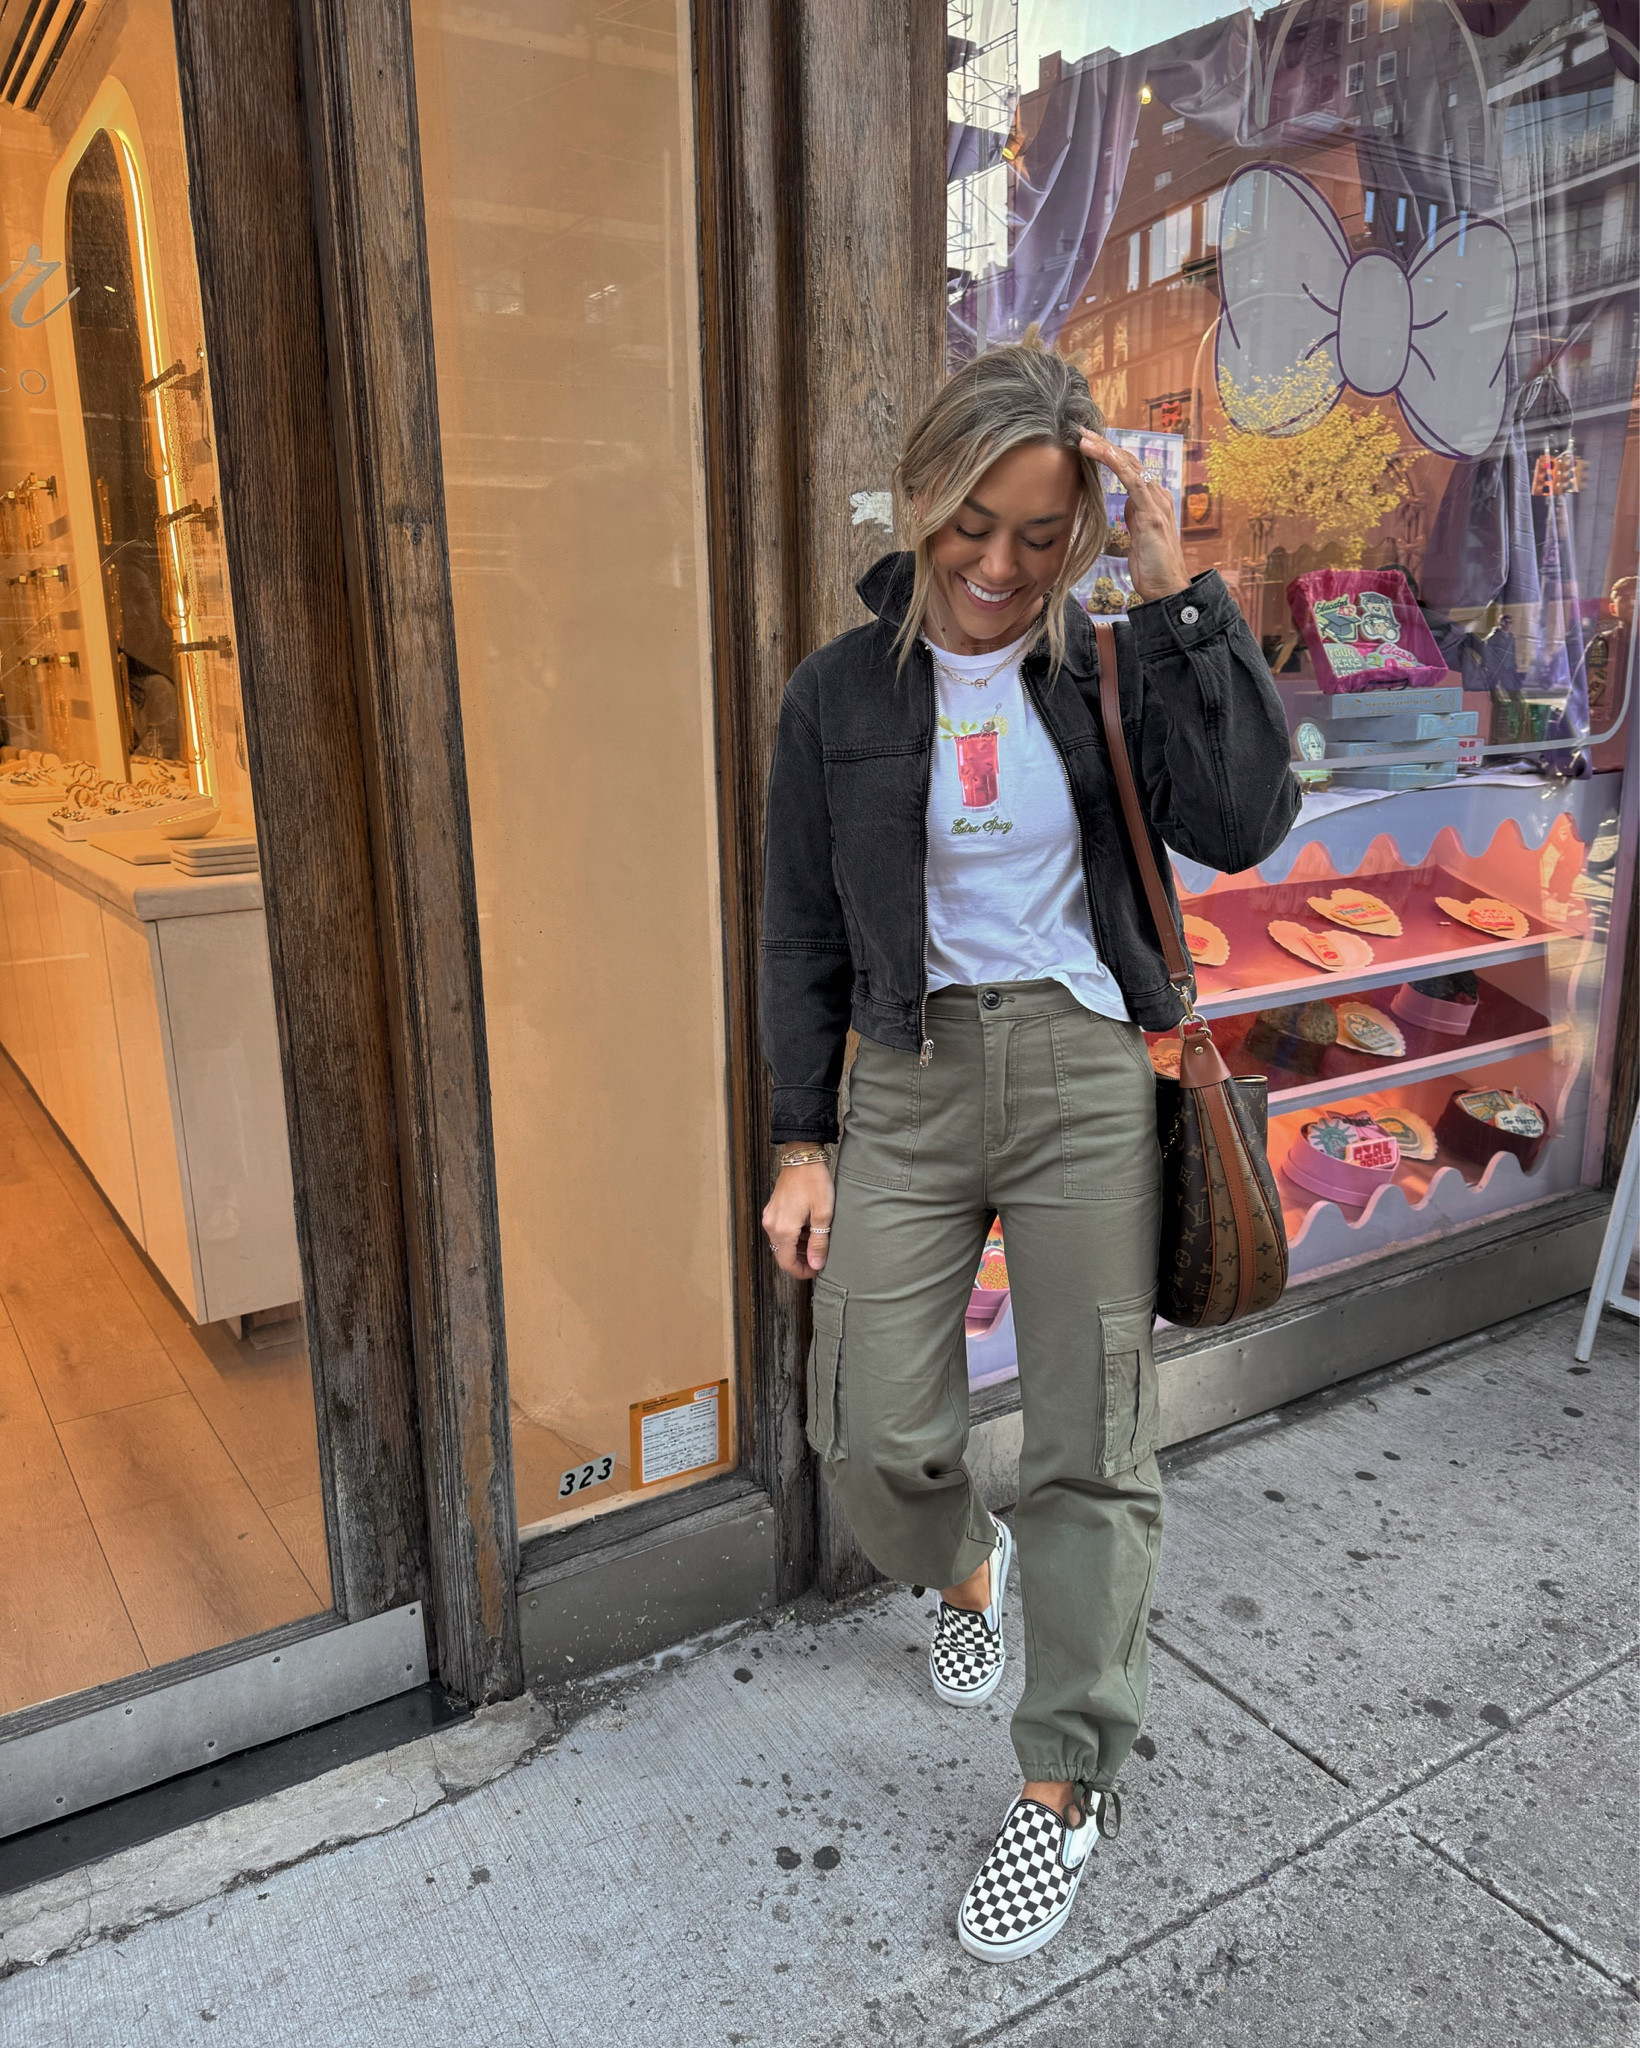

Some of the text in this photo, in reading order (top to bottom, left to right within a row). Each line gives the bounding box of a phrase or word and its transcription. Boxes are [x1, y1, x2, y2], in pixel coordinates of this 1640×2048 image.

[1315, 596, 1348, 613] Educated
[1380, 644, 1415, 662] Class
[951, 815, 1013, 835] Extra Spicy
[560, 1457, 612, 1496] 323
